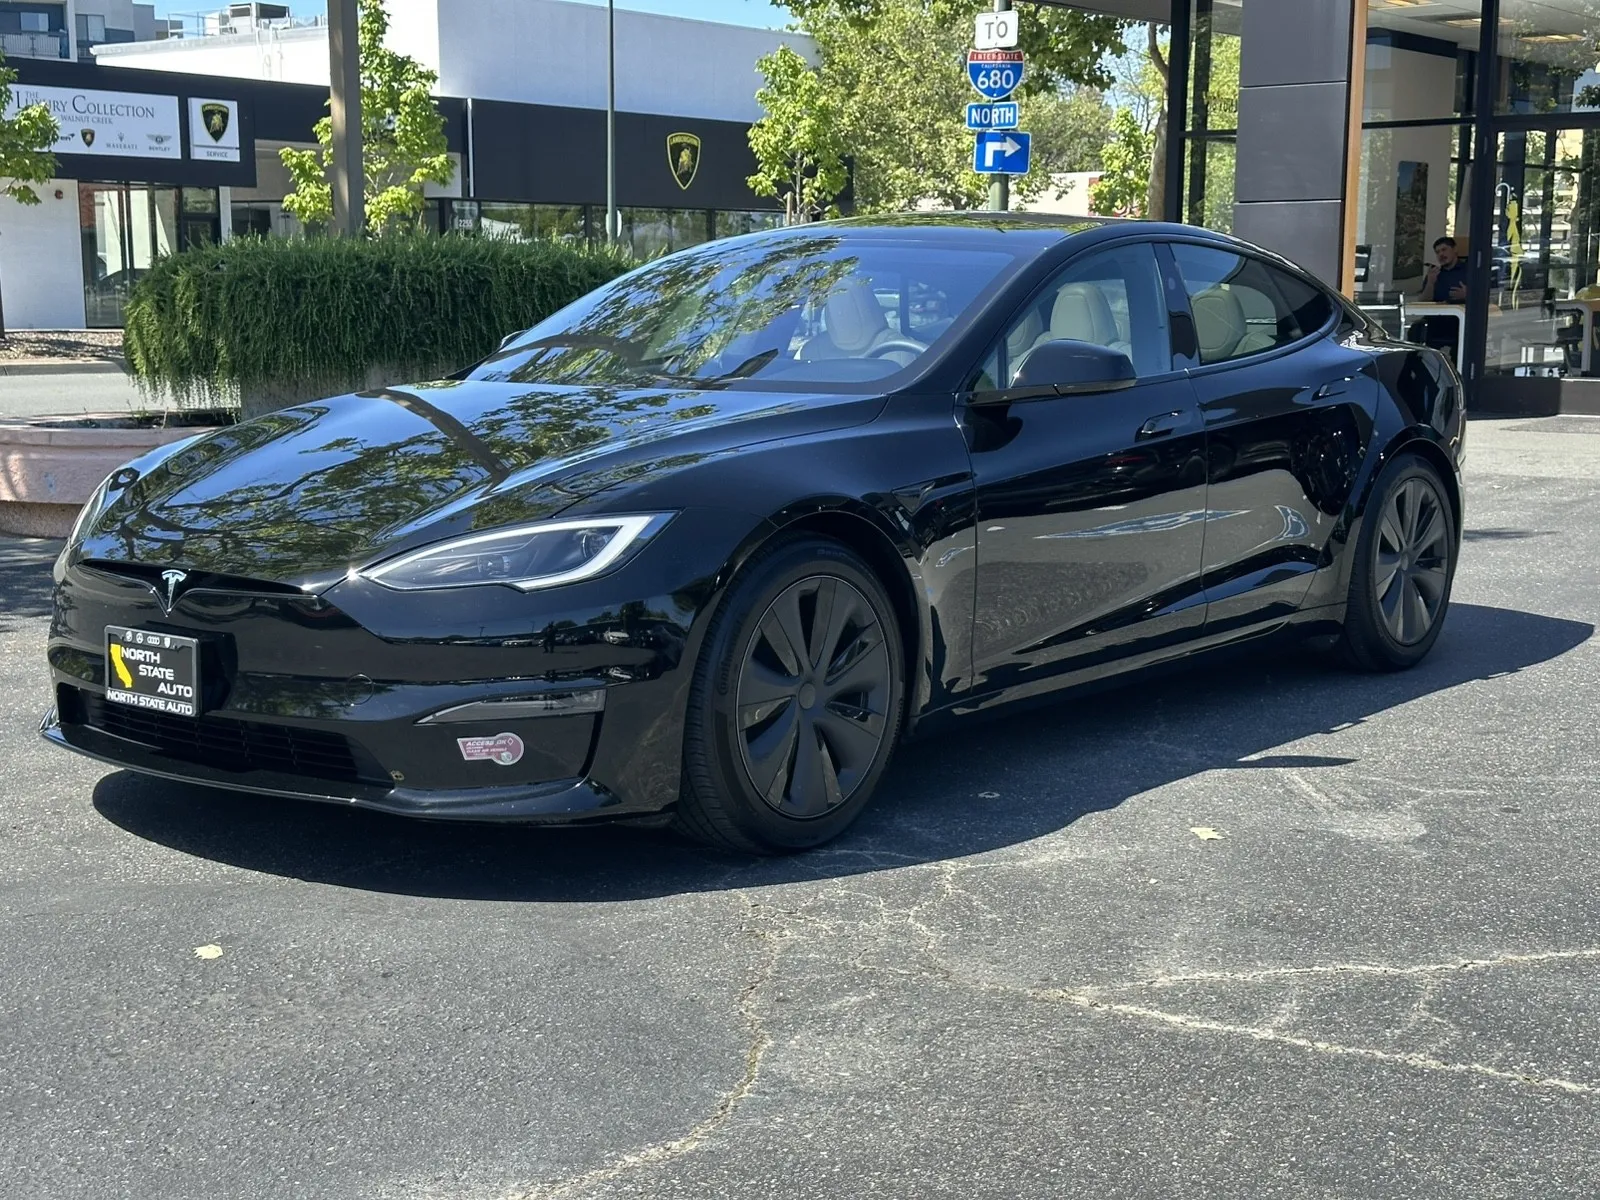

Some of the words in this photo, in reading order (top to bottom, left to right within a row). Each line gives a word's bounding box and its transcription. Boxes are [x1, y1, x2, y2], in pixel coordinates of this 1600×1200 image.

[985, 21, 1008, 39] TO
[977, 69, 1014, 89] 680
[25, 91, 39, 99] THE
[72, 94, 155, 119] COLLECTION
[60, 114, 90, 123] WALNUT
[91, 116, 114, 125] CREEK
[971, 107, 1014, 126] NORTH
[206, 150, 229, 158] SERVICE
[121, 646, 160, 664] NORTH
[138, 664, 174, 681] STATE
[157, 682, 193, 698] AUTO
[107, 689, 138, 705] NORTH
[139, 696, 165, 710] STATE
[166, 701, 193, 715] AUTO
